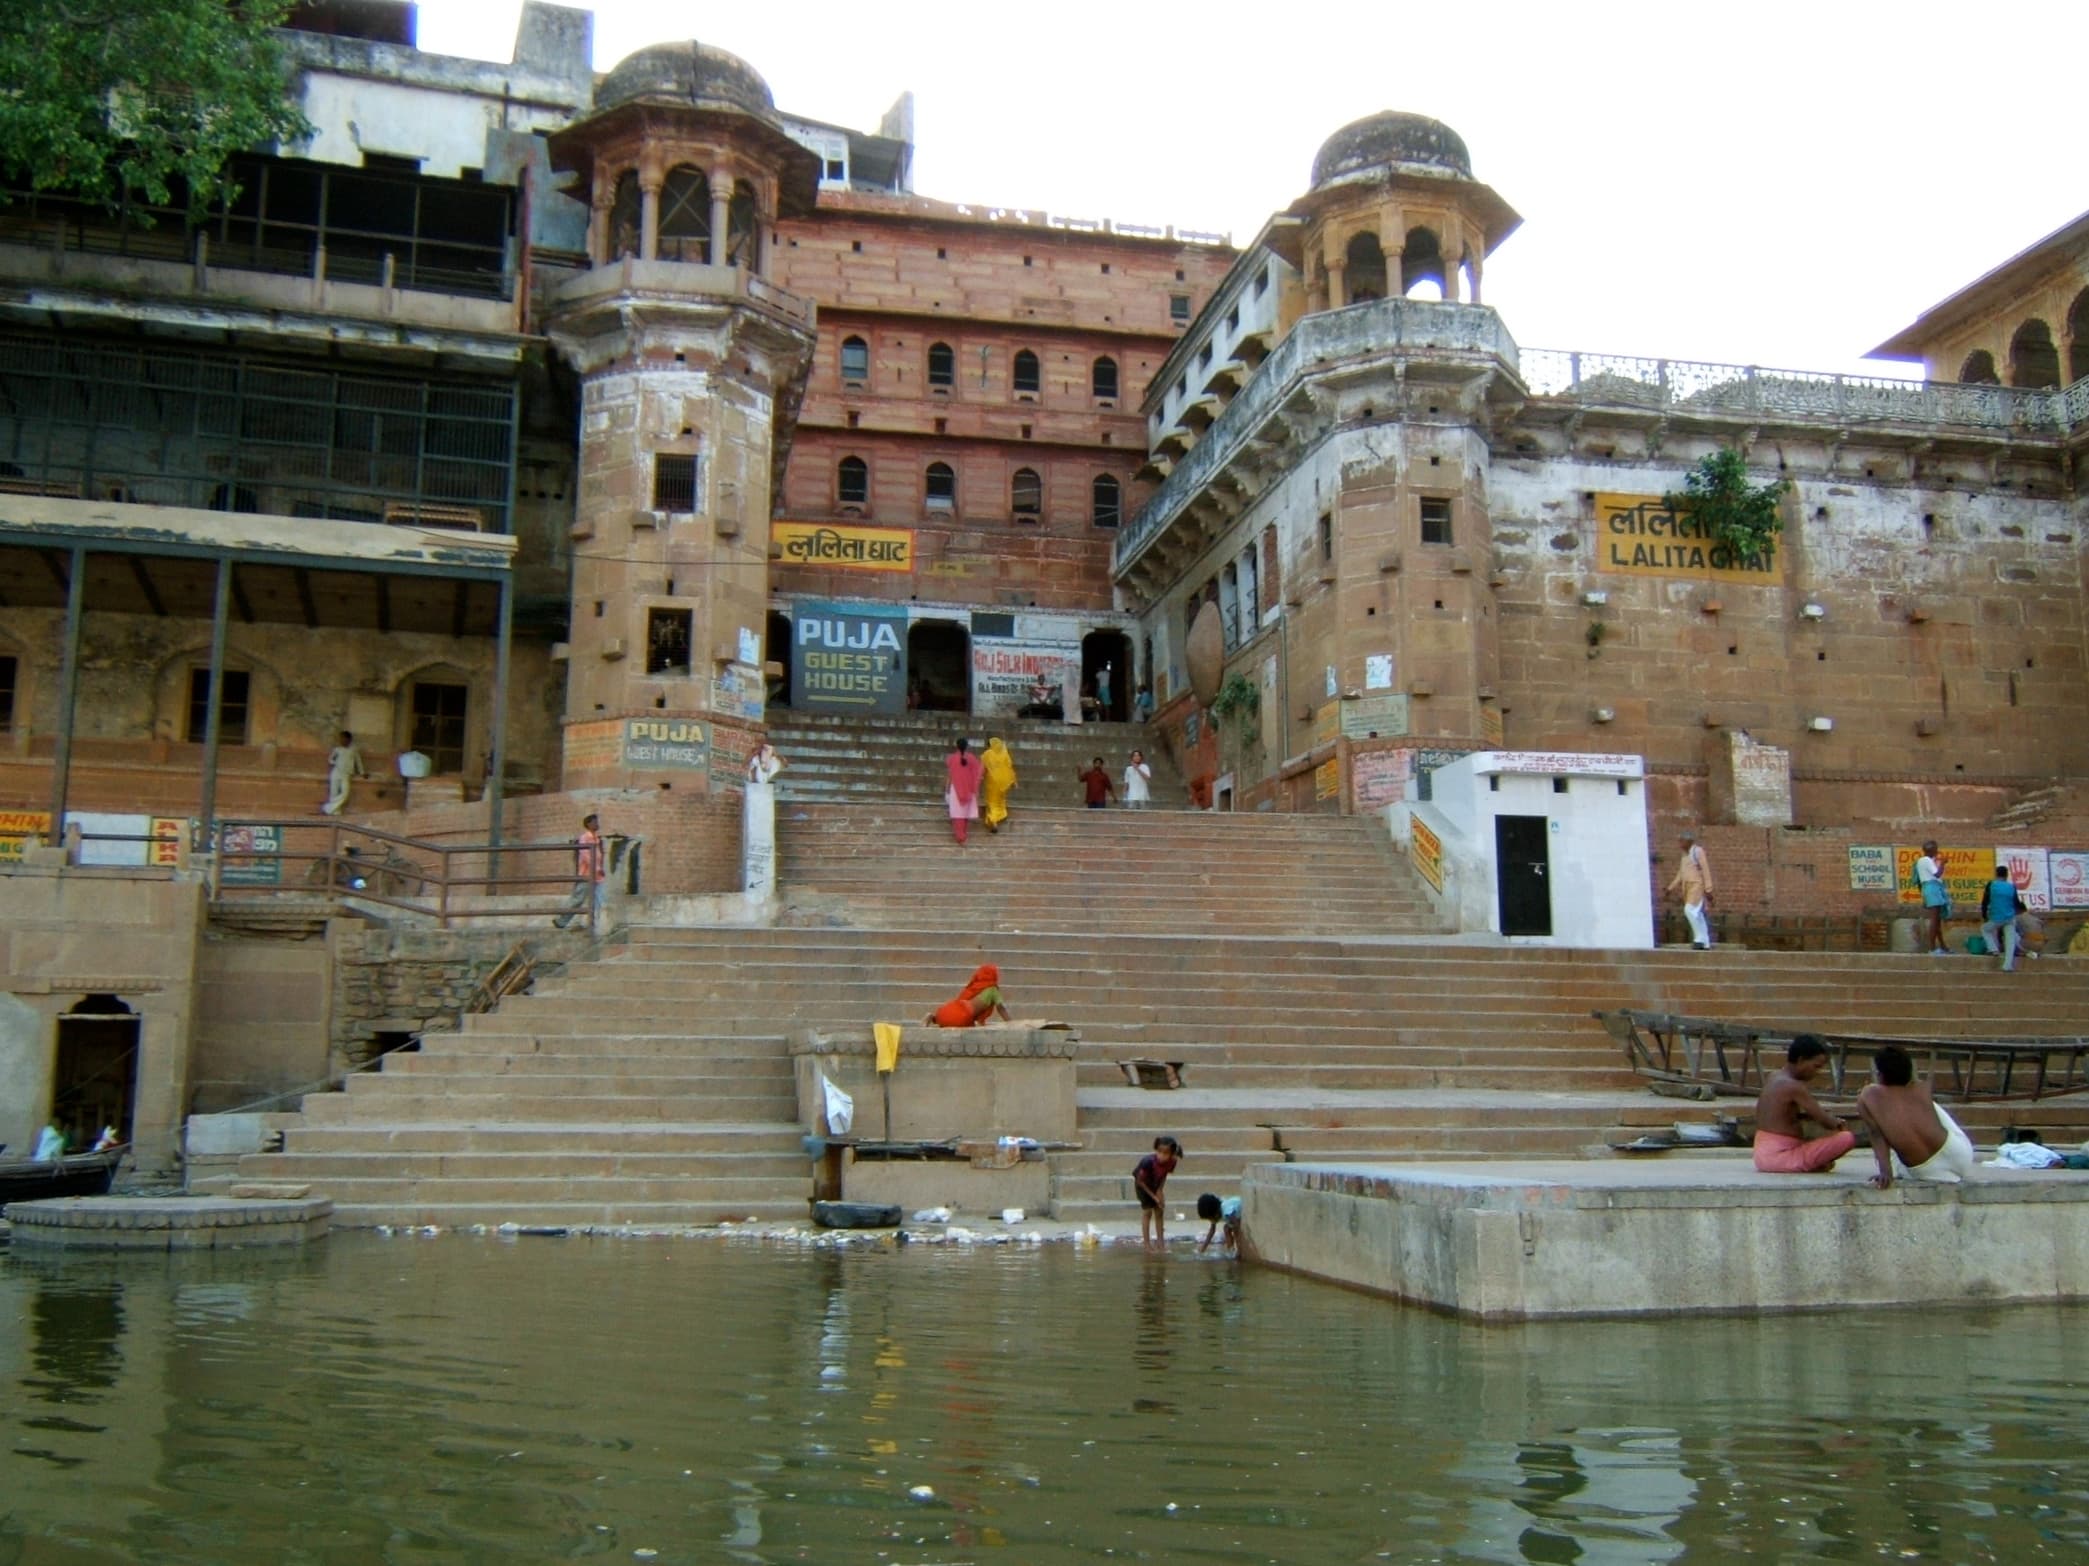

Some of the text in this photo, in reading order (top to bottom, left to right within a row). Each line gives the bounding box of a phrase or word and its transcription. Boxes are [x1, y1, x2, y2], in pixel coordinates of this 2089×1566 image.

[787, 528, 907, 561] ललिता घाट
[1611, 543, 1773, 572] LALITA GHAT
[799, 618, 902, 651] PUJA
[805, 652, 888, 672] GUEST
[804, 672, 888, 693] HOUSE
[630, 722, 704, 743] PUJA
[1851, 849, 1882, 860] BABA
[1899, 850, 1976, 865] DOPHIN
[1858, 875, 1886, 884] MUSIC
[1953, 879, 1988, 890] GUES
